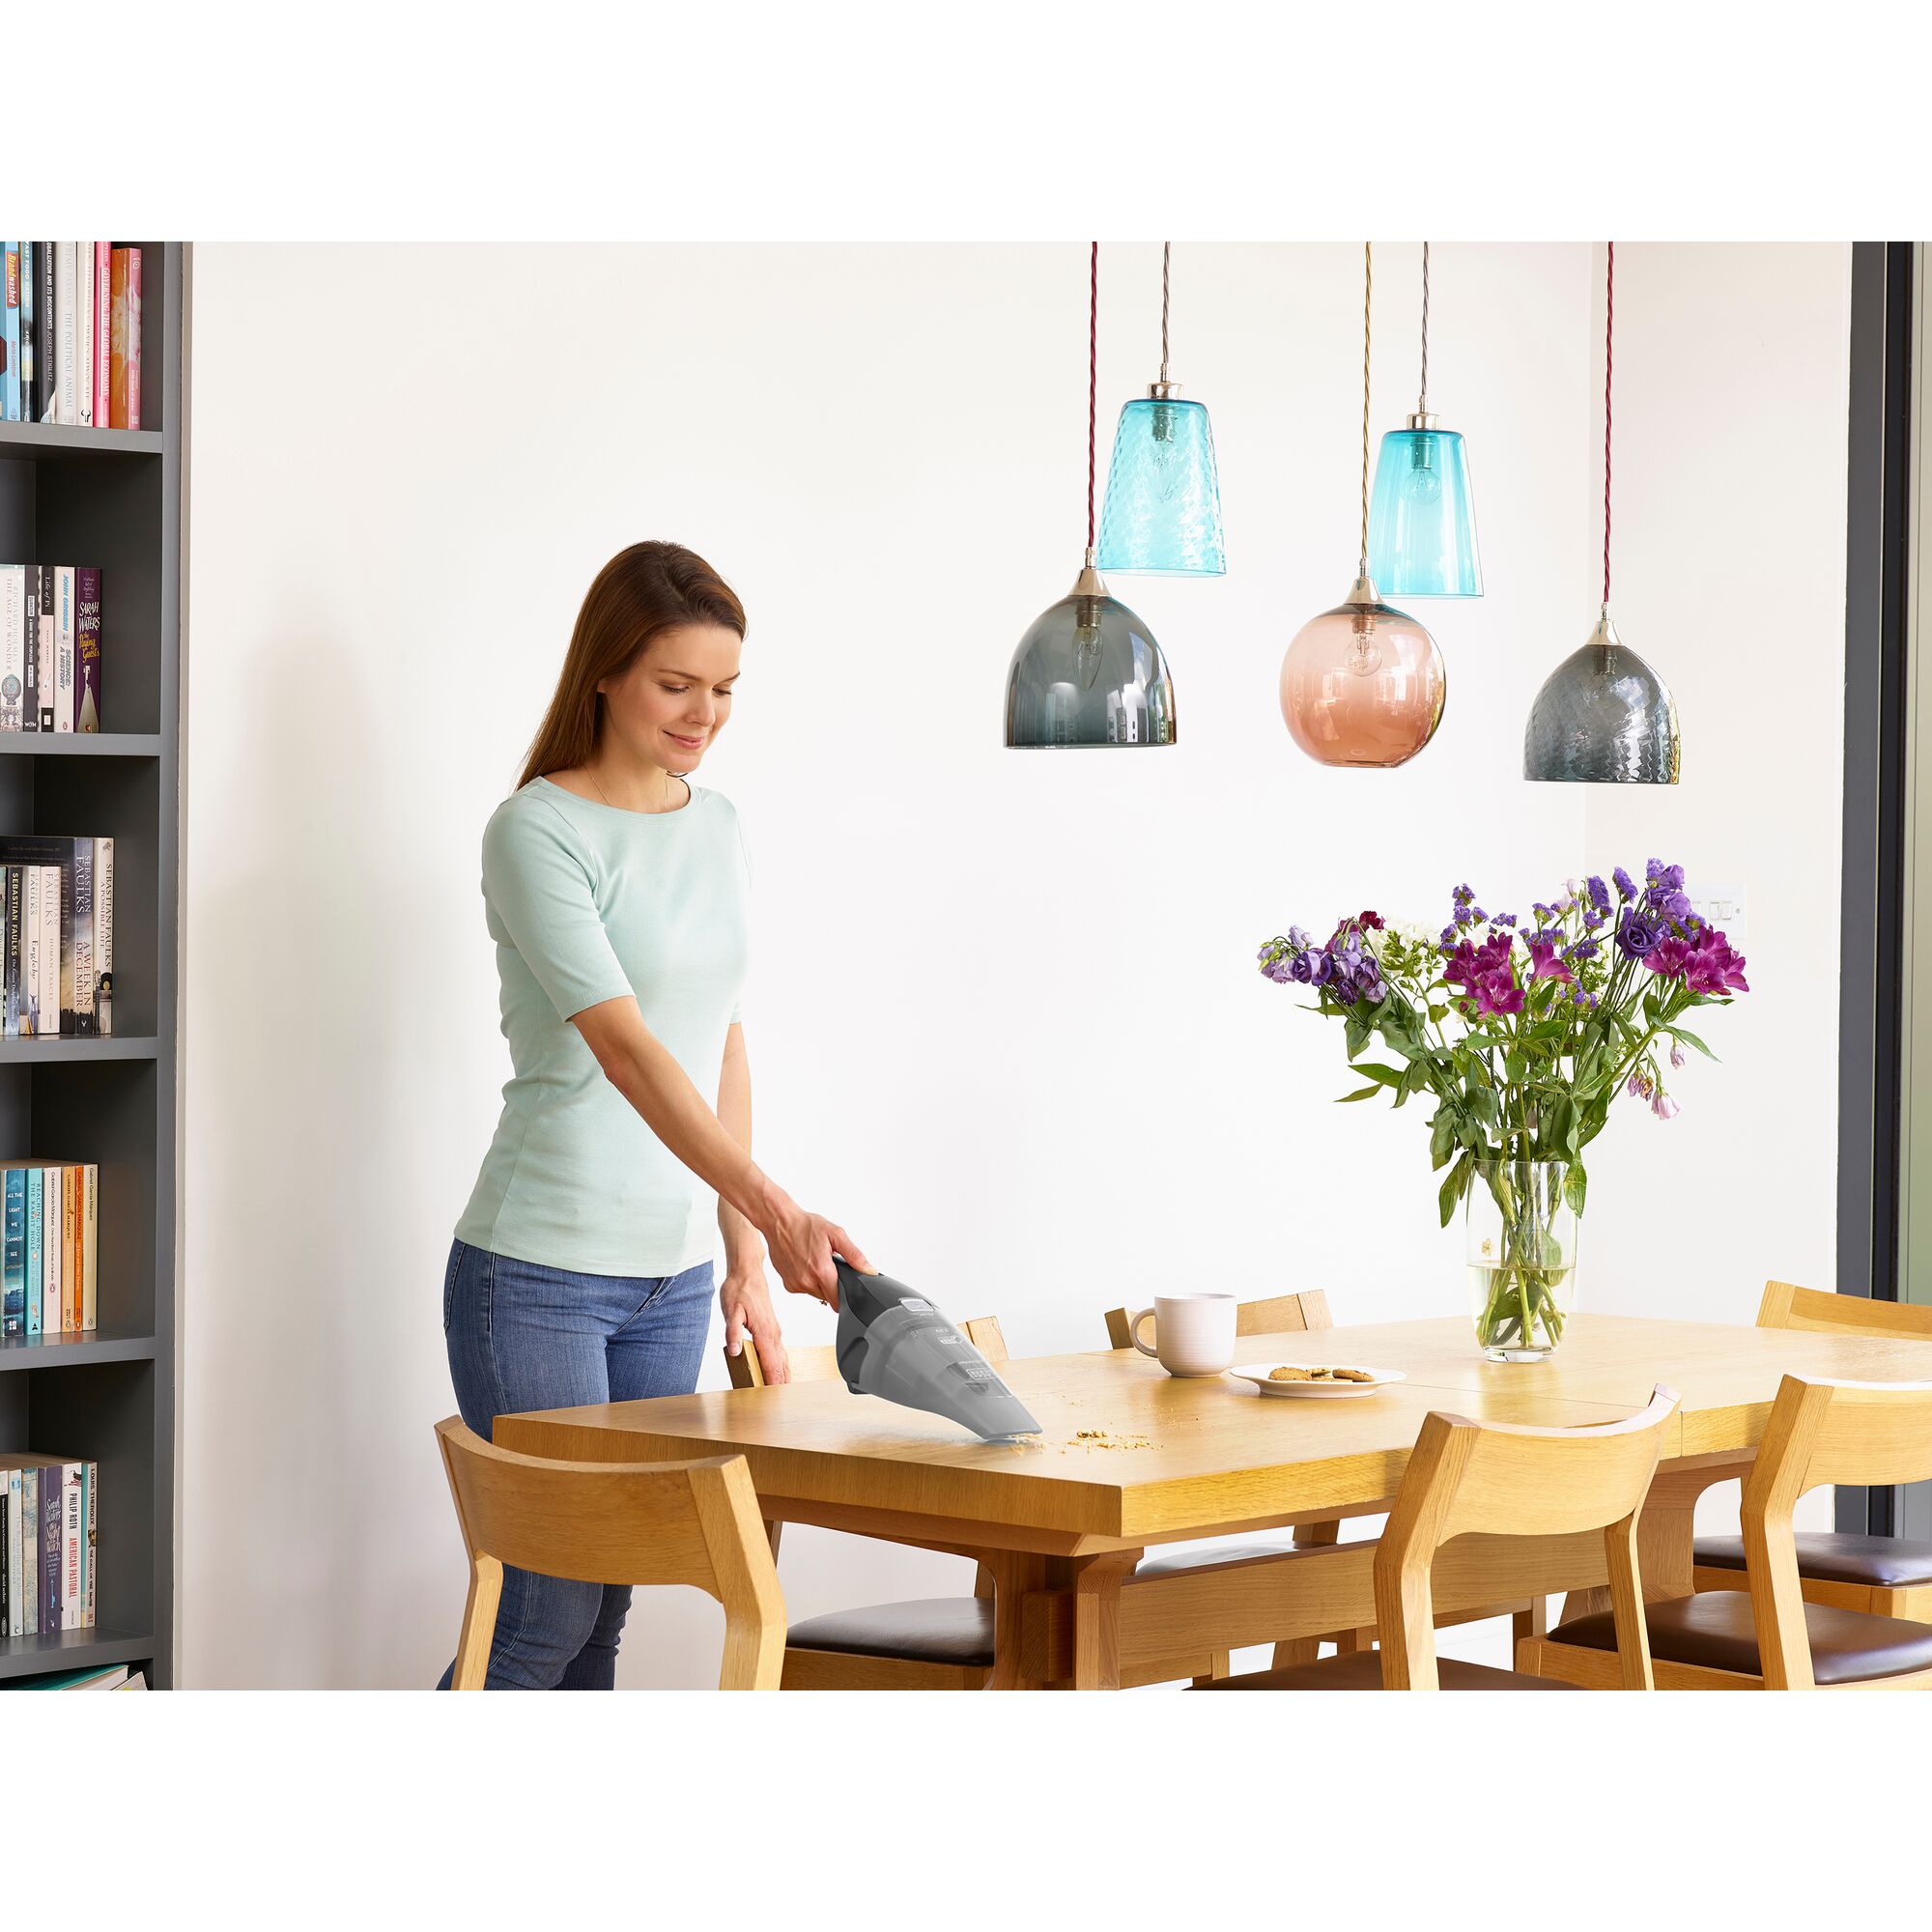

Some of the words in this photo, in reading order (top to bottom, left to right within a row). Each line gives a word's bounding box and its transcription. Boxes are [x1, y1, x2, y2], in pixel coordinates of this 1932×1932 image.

[8, 254, 17, 304] Brandwashed
[79, 601, 99, 616] SARAH
[6, 615, 12, 626] OF
[79, 616, 100, 633] WATERS
[79, 634, 95, 650] Paying
[82, 647, 99, 663] Guests
[76, 856, 85, 913] FAULKS
[45, 873, 54, 926] FAULKS
[12, 958, 16, 967] On
[83, 991, 91, 1006] IN
[46, 1495, 61, 1512] Sarah
